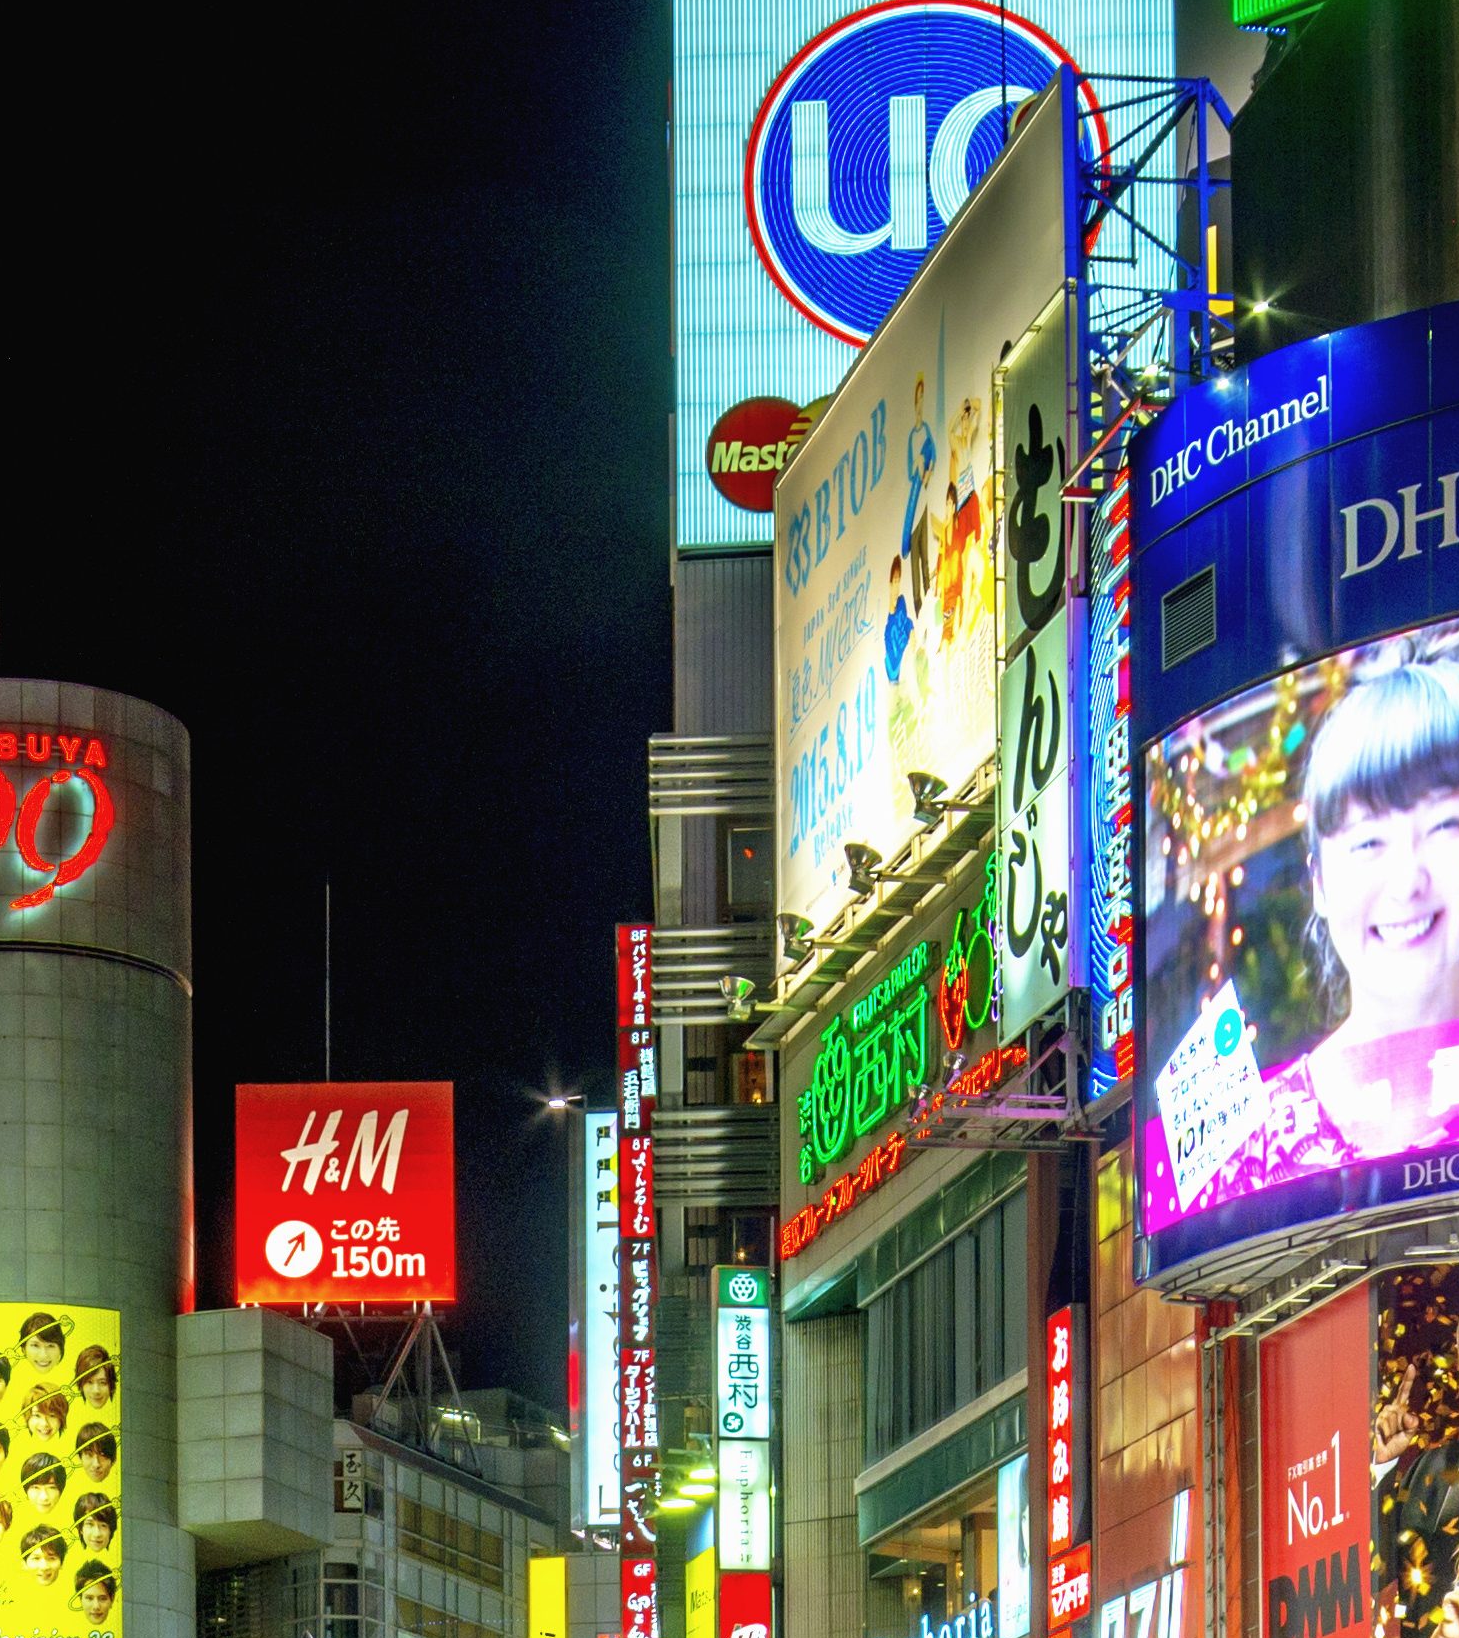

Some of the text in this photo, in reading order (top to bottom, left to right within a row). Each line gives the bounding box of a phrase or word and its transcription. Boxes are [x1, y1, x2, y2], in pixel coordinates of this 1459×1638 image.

[1151, 376, 1330, 507] DHC Channel
[811, 397, 888, 566] BTOB
[1007, 403, 1068, 986] もんじゃ
[790, 665, 877, 858] 2015.8.19
[813, 809, 853, 866] Release
[631, 929, 647, 943] 8F
[633, 944, 646, 1026] パンケーキの店
[631, 1030, 649, 1044] 8F
[854, 984, 929, 1138] 西村
[280, 1108, 409, 1194] H&M
[633, 1138, 650, 1151] 8F
[797, 1091, 814, 1184] 渋谷
[330, 1217, 401, 1243] この先
[331, 1245, 426, 1279] 150m
[632, 1242, 650, 1256] 7F
[633, 1348, 649, 1362] 7F
[728, 1313, 760, 1410] 渋谷西村
[727, 1416, 742, 1431] 5F
[632, 1453, 652, 1467] 6F
[1286, 1430, 1345, 1546] No.1
[736, 1450, 754, 1545] Euphoria
[633, 1563, 651, 1577] 6F
